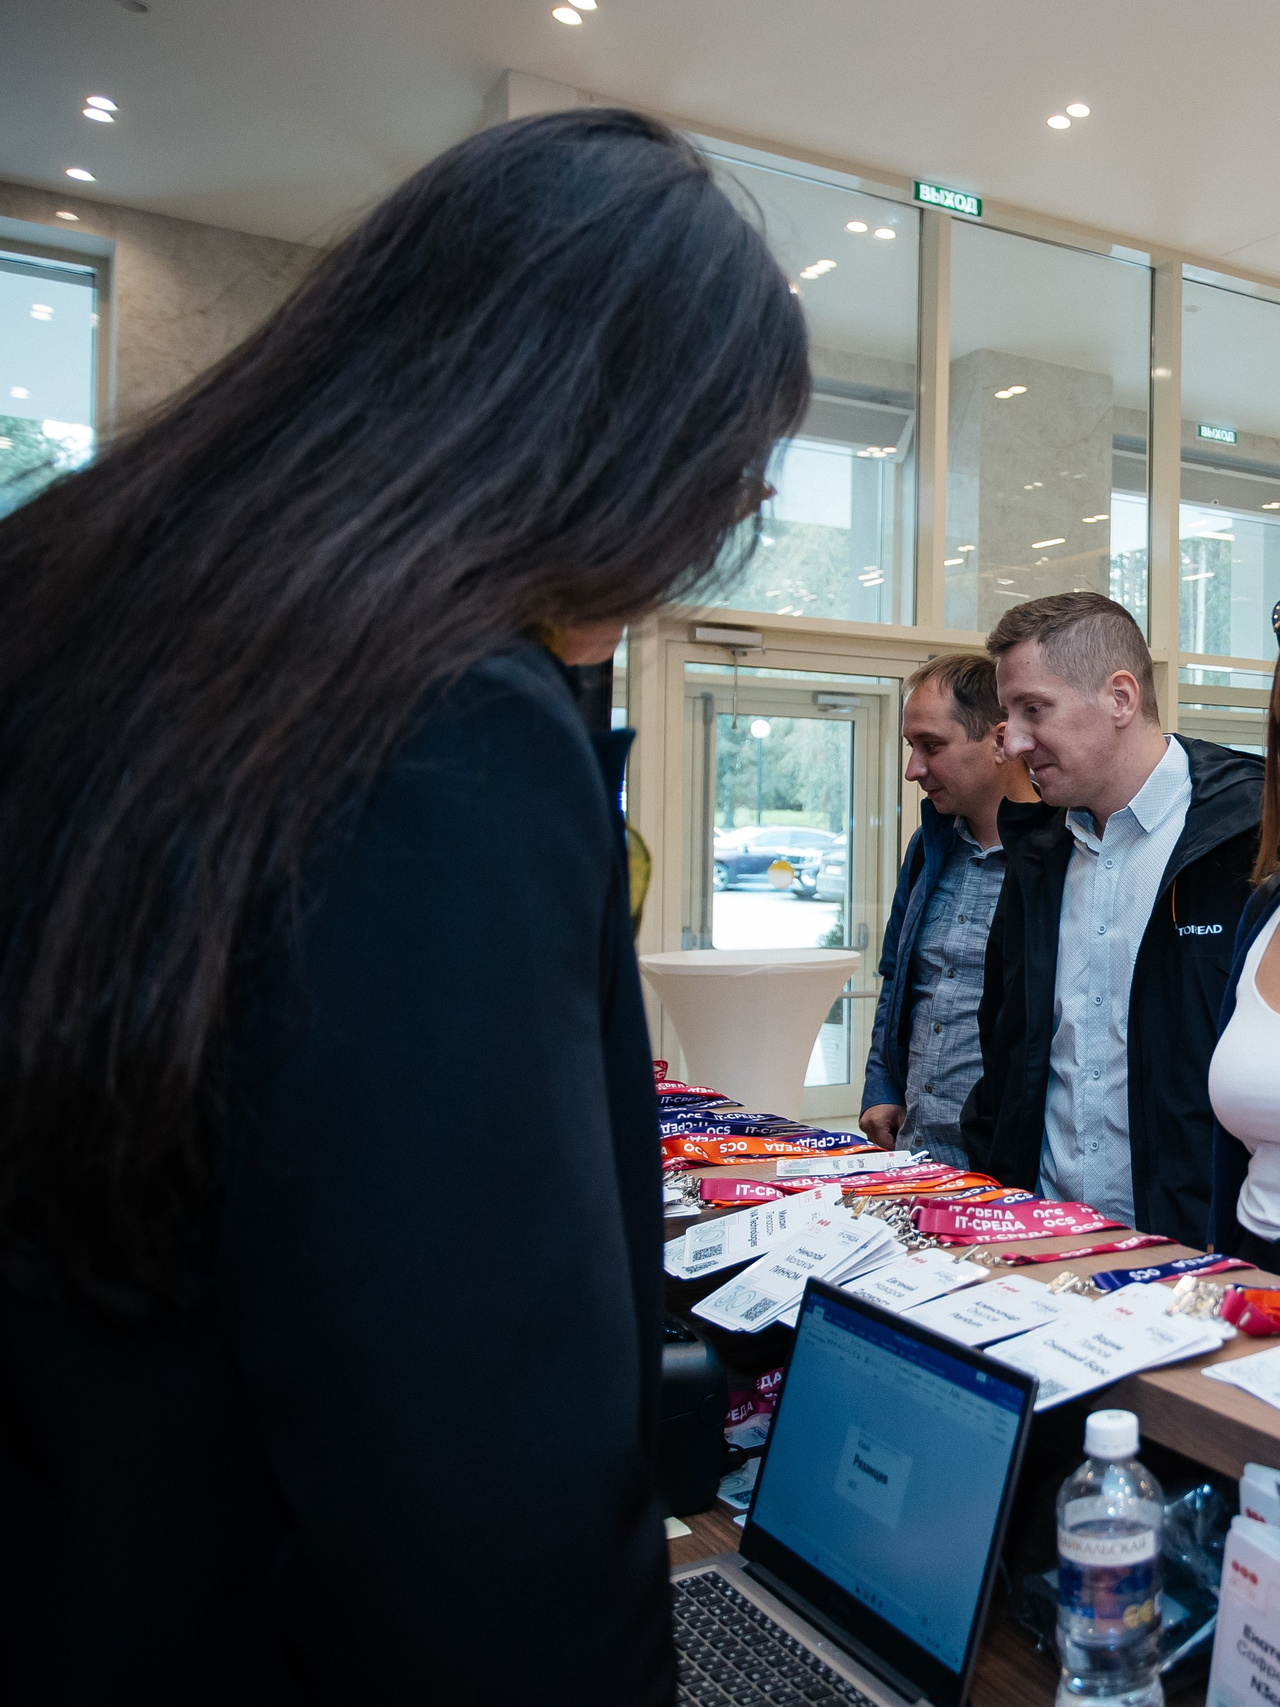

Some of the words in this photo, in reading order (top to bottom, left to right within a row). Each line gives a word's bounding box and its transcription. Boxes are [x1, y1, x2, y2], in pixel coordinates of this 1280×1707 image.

[919, 183, 978, 216] ВЫХОД
[1200, 425, 1235, 443] ВЫХОД
[1178, 924, 1223, 937] TOREAD
[683, 1143, 709, 1158] OCS
[719, 1141, 748, 1153] OCS
[736, 1184, 786, 1198] IT-СРЕ
[1003, 1193, 1034, 1203] OCS
[955, 1215, 1027, 1232] IT-СРЕДА
[1043, 1216, 1076, 1227] OCS
[976, 1230, 1053, 1242] IT-СРЕДА
[1070, 1222, 1103, 1232] OCS
[795, 1246, 827, 1261] Николай
[1129, 1268, 1161, 1281] OCS
